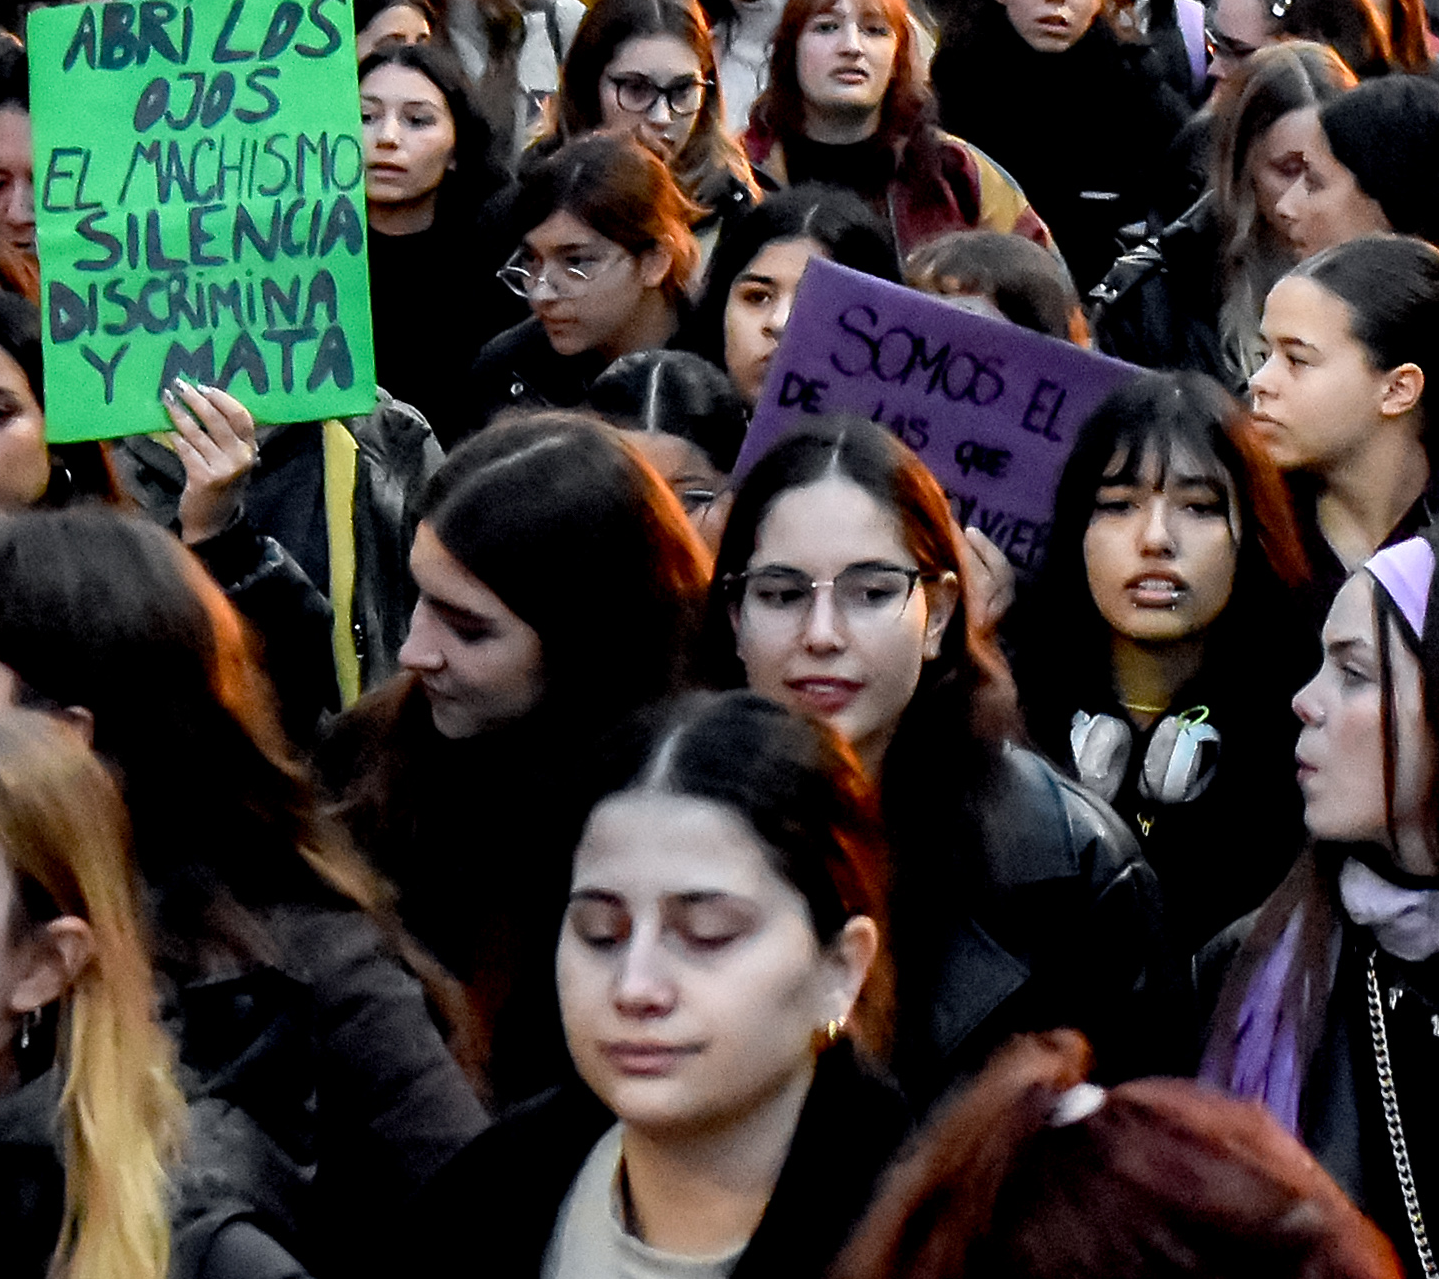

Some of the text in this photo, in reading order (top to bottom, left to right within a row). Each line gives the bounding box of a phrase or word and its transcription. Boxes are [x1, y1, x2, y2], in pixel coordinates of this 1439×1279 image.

[132, 65, 281, 134] OJOS
[41, 130, 363, 214] EL MACHISMO
[72, 193, 364, 273] SILENCIA
[79, 323, 356, 405] Y MATA
[776, 369, 831, 415] DE
